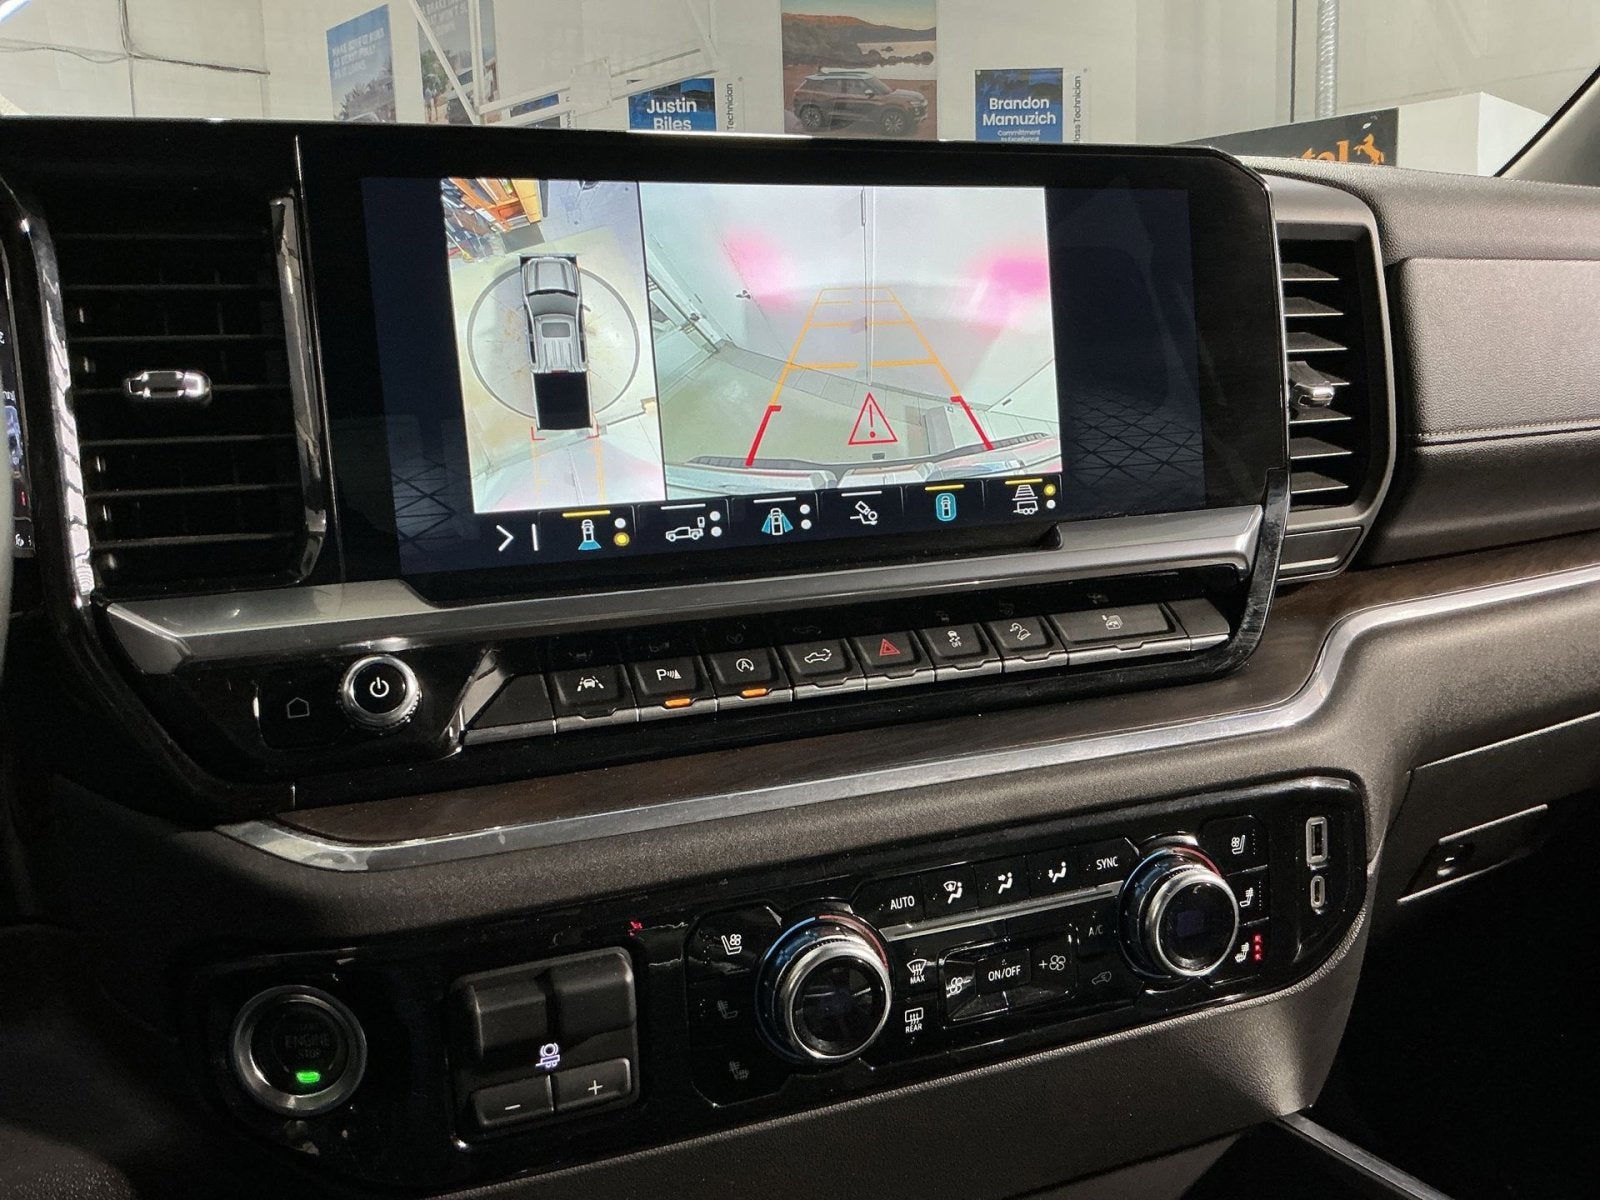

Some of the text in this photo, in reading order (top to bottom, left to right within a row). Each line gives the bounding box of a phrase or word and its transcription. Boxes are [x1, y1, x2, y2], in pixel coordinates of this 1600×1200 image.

[646, 97, 697, 114] Justin
[725, 83, 733, 131] Technician
[989, 96, 1050, 110] Brandon
[1072, 75, 1081, 143] lass Technician
[653, 116, 692, 131] Biles
[982, 111, 1056, 126] Mamuzich
[1096, 856, 1119, 870] SYNC
[890, 895, 915, 910] AUTO
[1088, 925, 1103, 937] A/C
[910, 974, 925, 984] MAX
[988, 965, 1021, 981] ON/OFF
[905, 1023, 923, 1033] REAR
